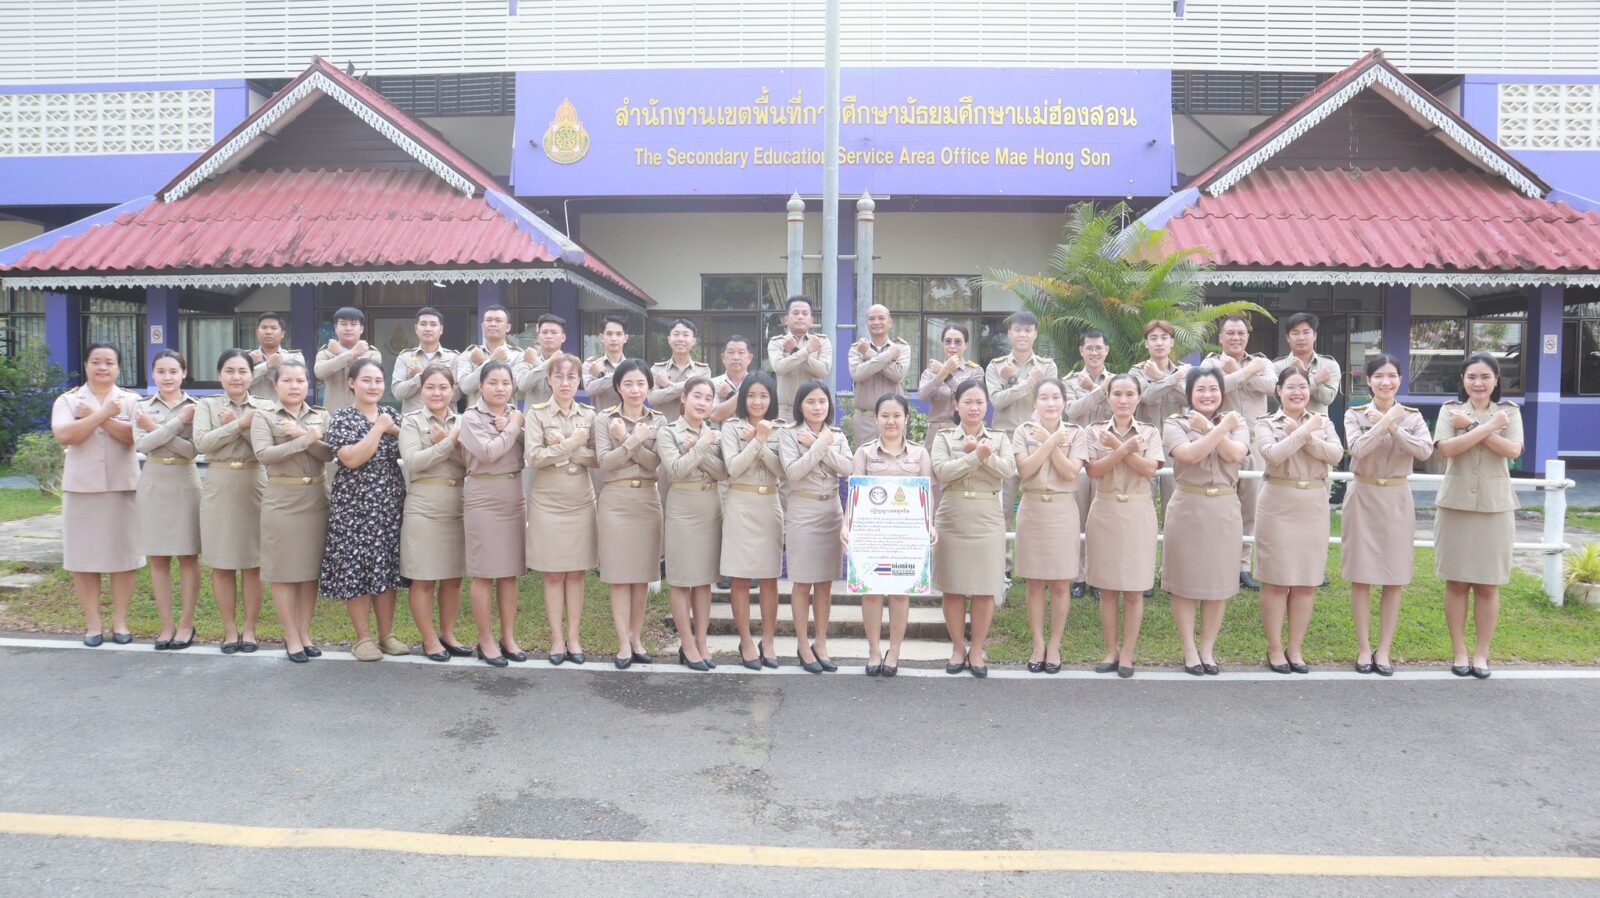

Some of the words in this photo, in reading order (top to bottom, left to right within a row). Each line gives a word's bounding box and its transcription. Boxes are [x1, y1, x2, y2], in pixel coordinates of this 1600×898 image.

[615, 86, 1137, 127] สำนักงานเขตพื้นที่กศึกษามัธยมศึกษาแม่ฮ่องสอน
[634, 148, 662, 166] The
[667, 147, 748, 169] Secondary
[838, 146, 894, 165] Service
[899, 147, 936, 165] Area
[941, 146, 990, 165] Office
[995, 147, 1028, 165] Mae
[1033, 147, 1075, 170] Hong
[1080, 147, 1111, 166] Son
